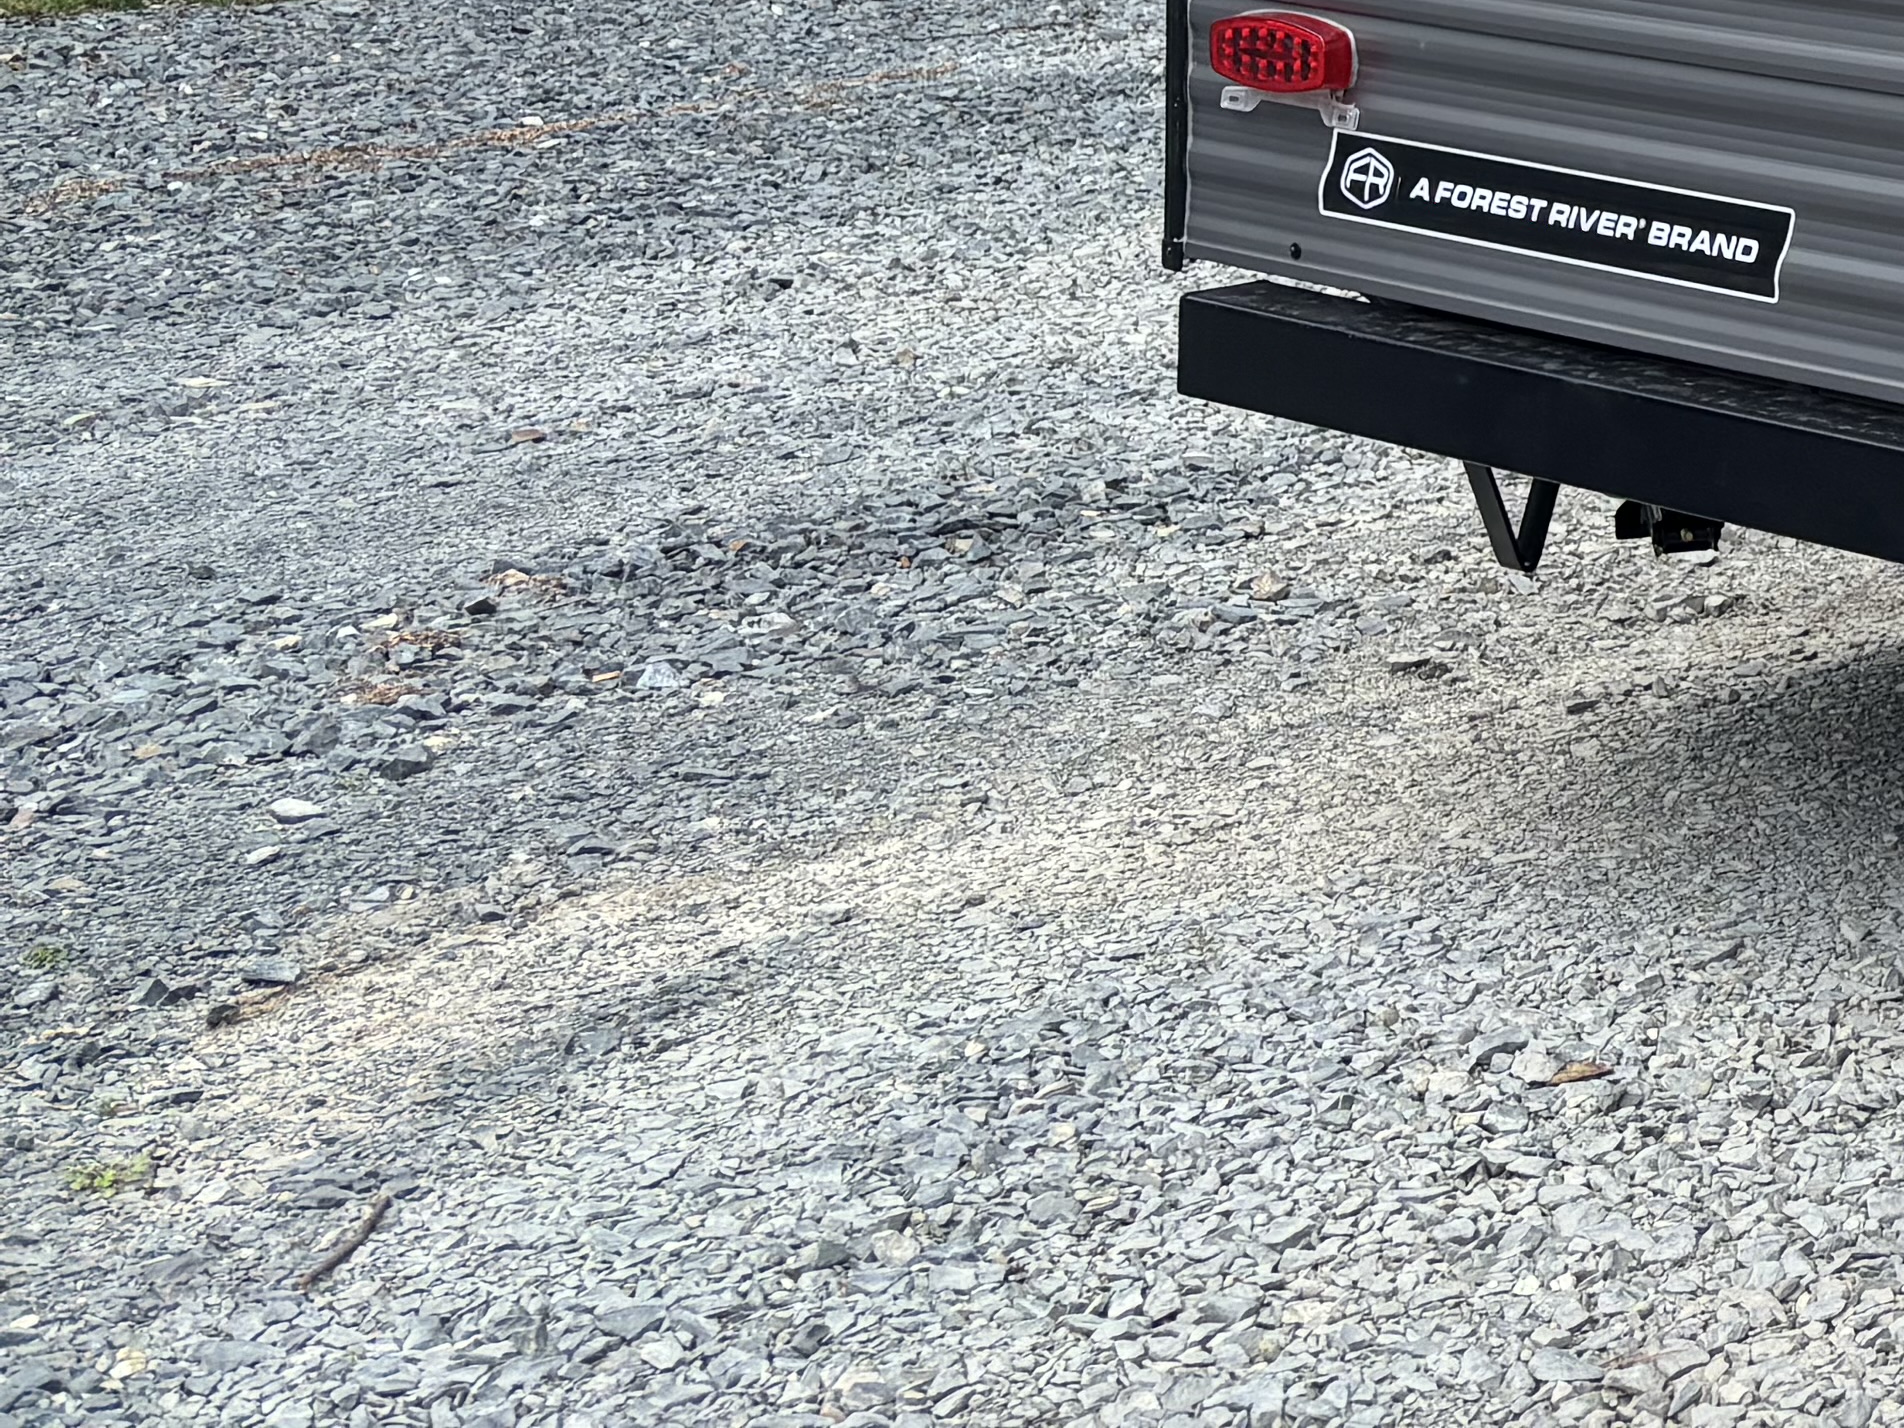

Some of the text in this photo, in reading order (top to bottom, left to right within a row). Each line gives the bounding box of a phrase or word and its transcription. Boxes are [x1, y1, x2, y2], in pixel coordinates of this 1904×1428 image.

[1410, 177, 1433, 200] A
[1434, 181, 1545, 222] FOREST
[1646, 221, 1760, 264] BRAND
